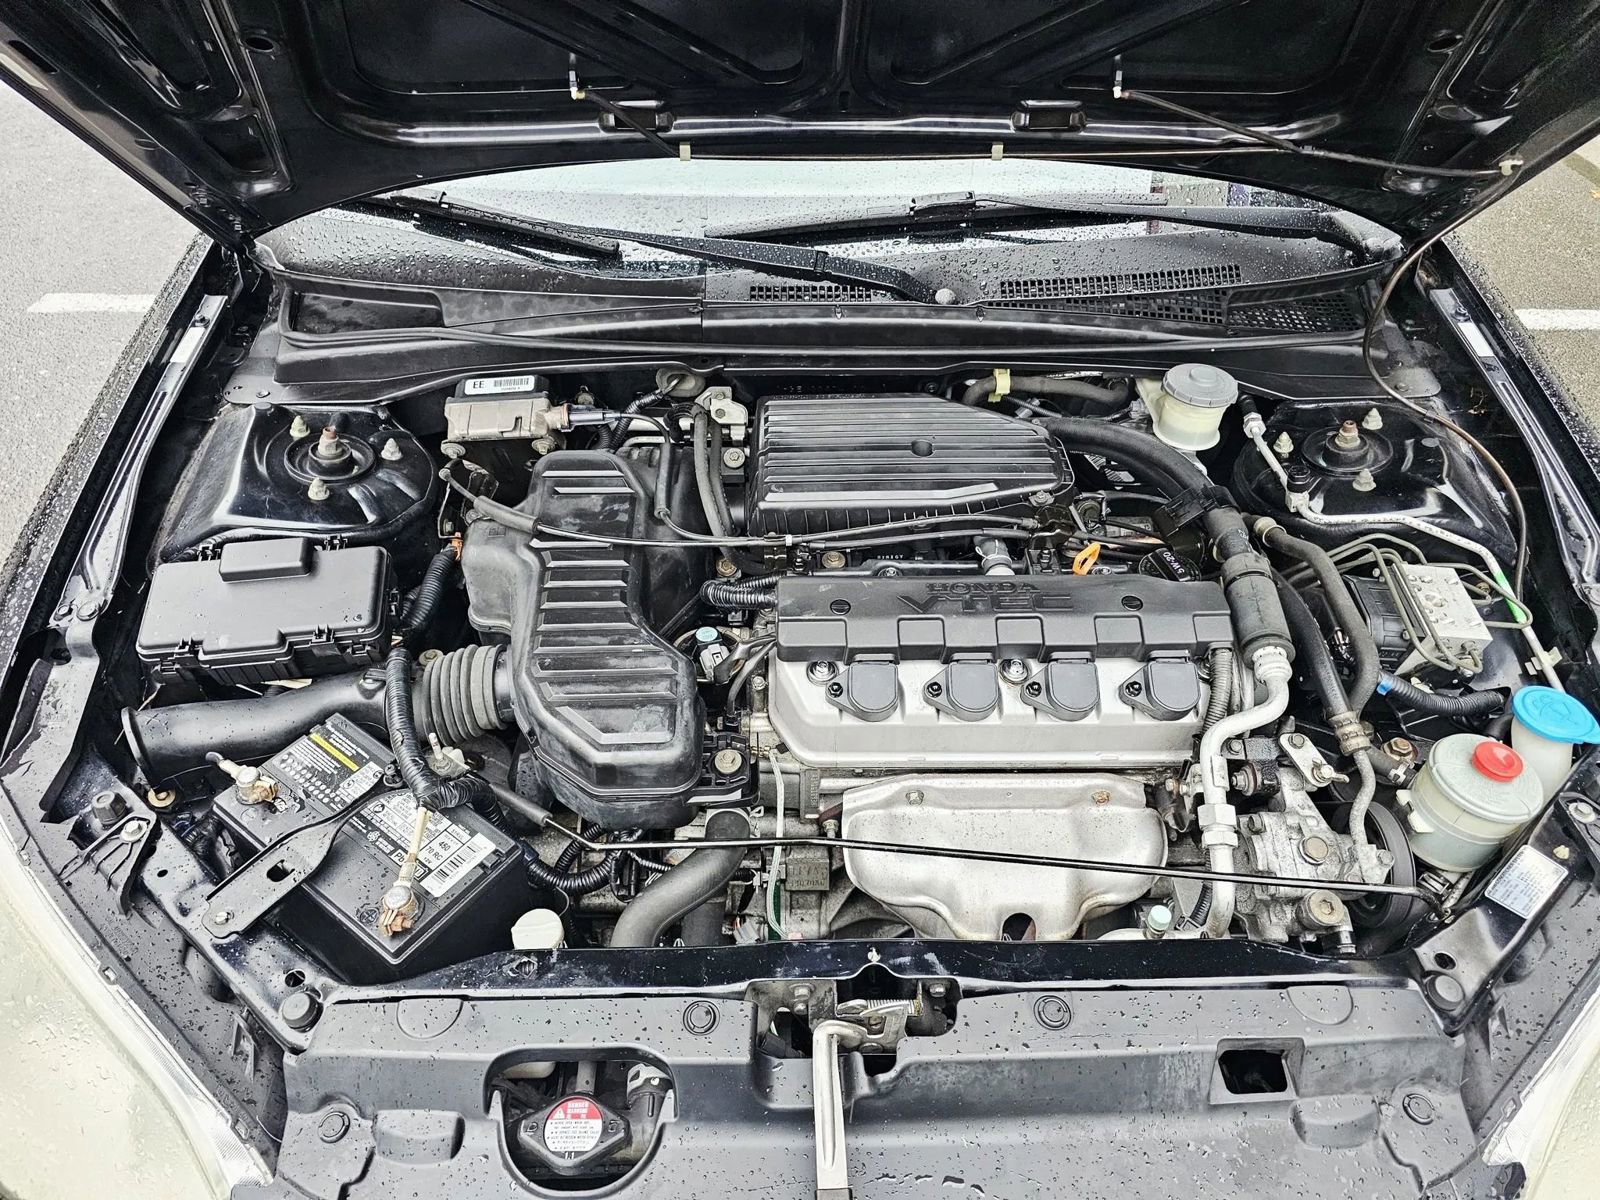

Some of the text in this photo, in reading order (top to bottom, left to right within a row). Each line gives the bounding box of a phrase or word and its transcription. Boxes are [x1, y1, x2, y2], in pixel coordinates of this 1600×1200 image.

[473, 380, 485, 389] EE
[1163, 551, 1185, 575] 5W-20
[926, 582, 1041, 594] HONDA
[897, 594, 1073, 613] VTEC
[438, 841, 451, 852] 450
[394, 852, 405, 863] Pb
[425, 846, 444, 861] 70 RC
